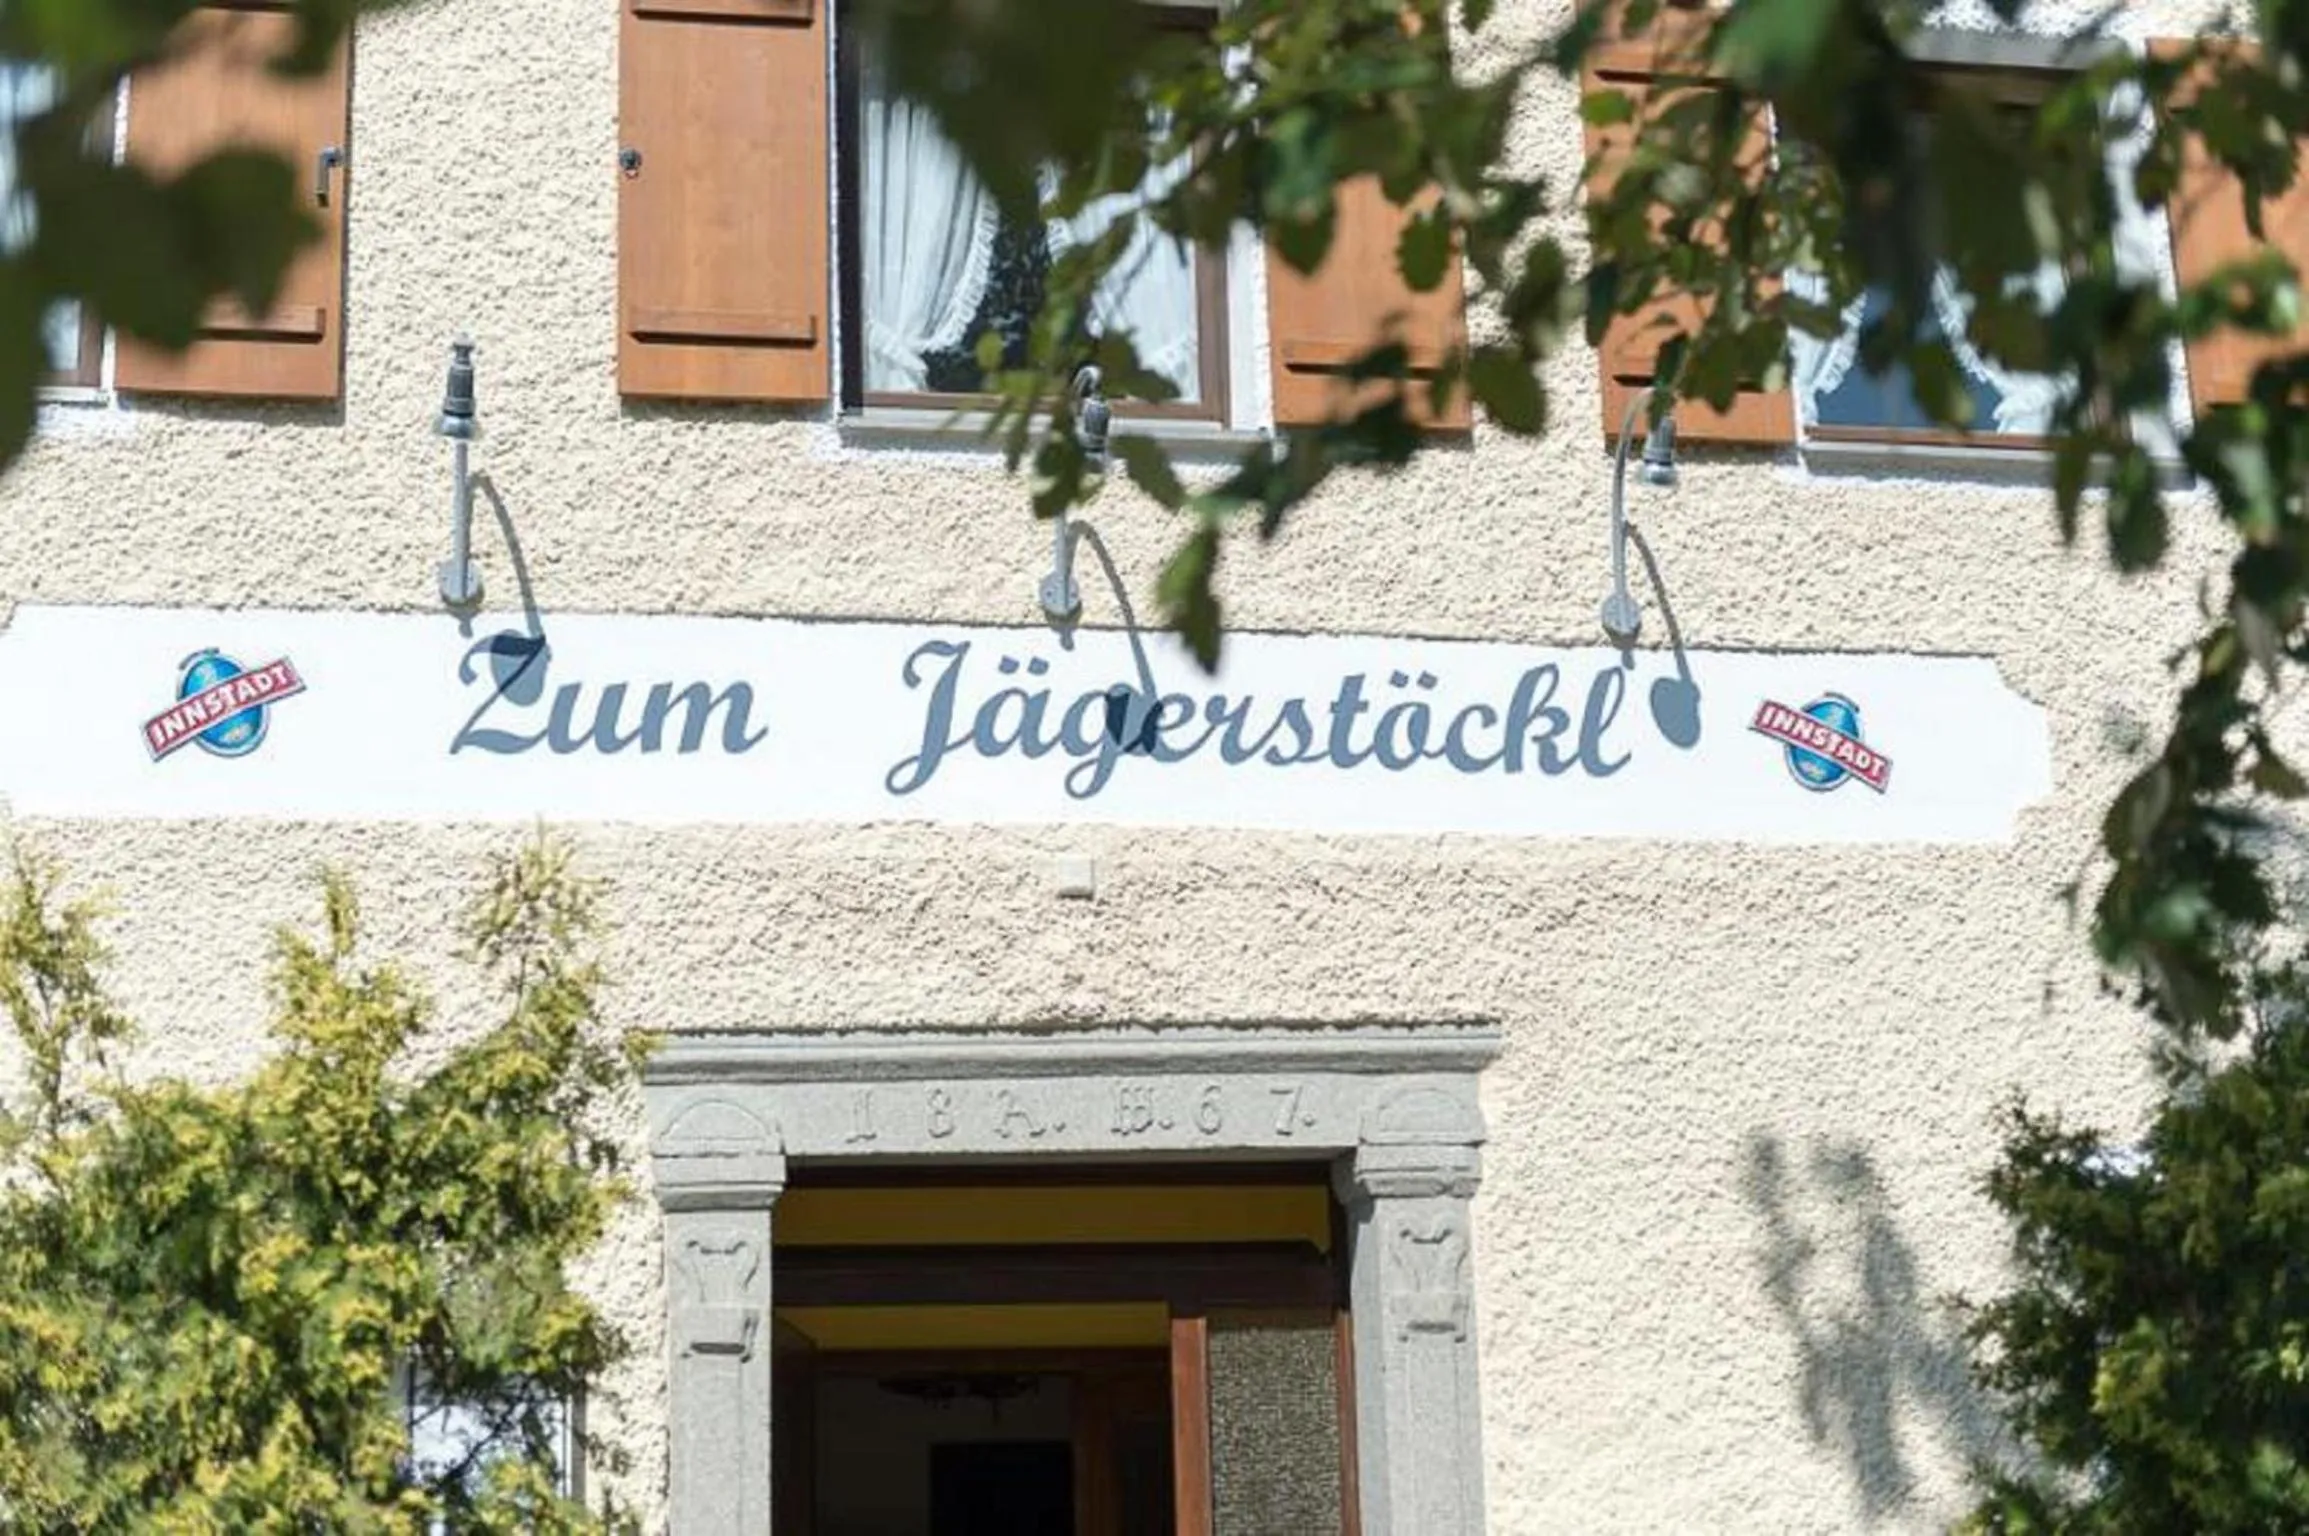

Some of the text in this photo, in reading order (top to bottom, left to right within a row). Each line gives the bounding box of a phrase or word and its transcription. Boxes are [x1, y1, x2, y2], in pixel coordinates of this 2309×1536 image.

[150, 664, 289, 747] INNSTADT
[449, 630, 1632, 800] Zum Jägerstöckl
[1760, 705, 1887, 778] INNSTADT
